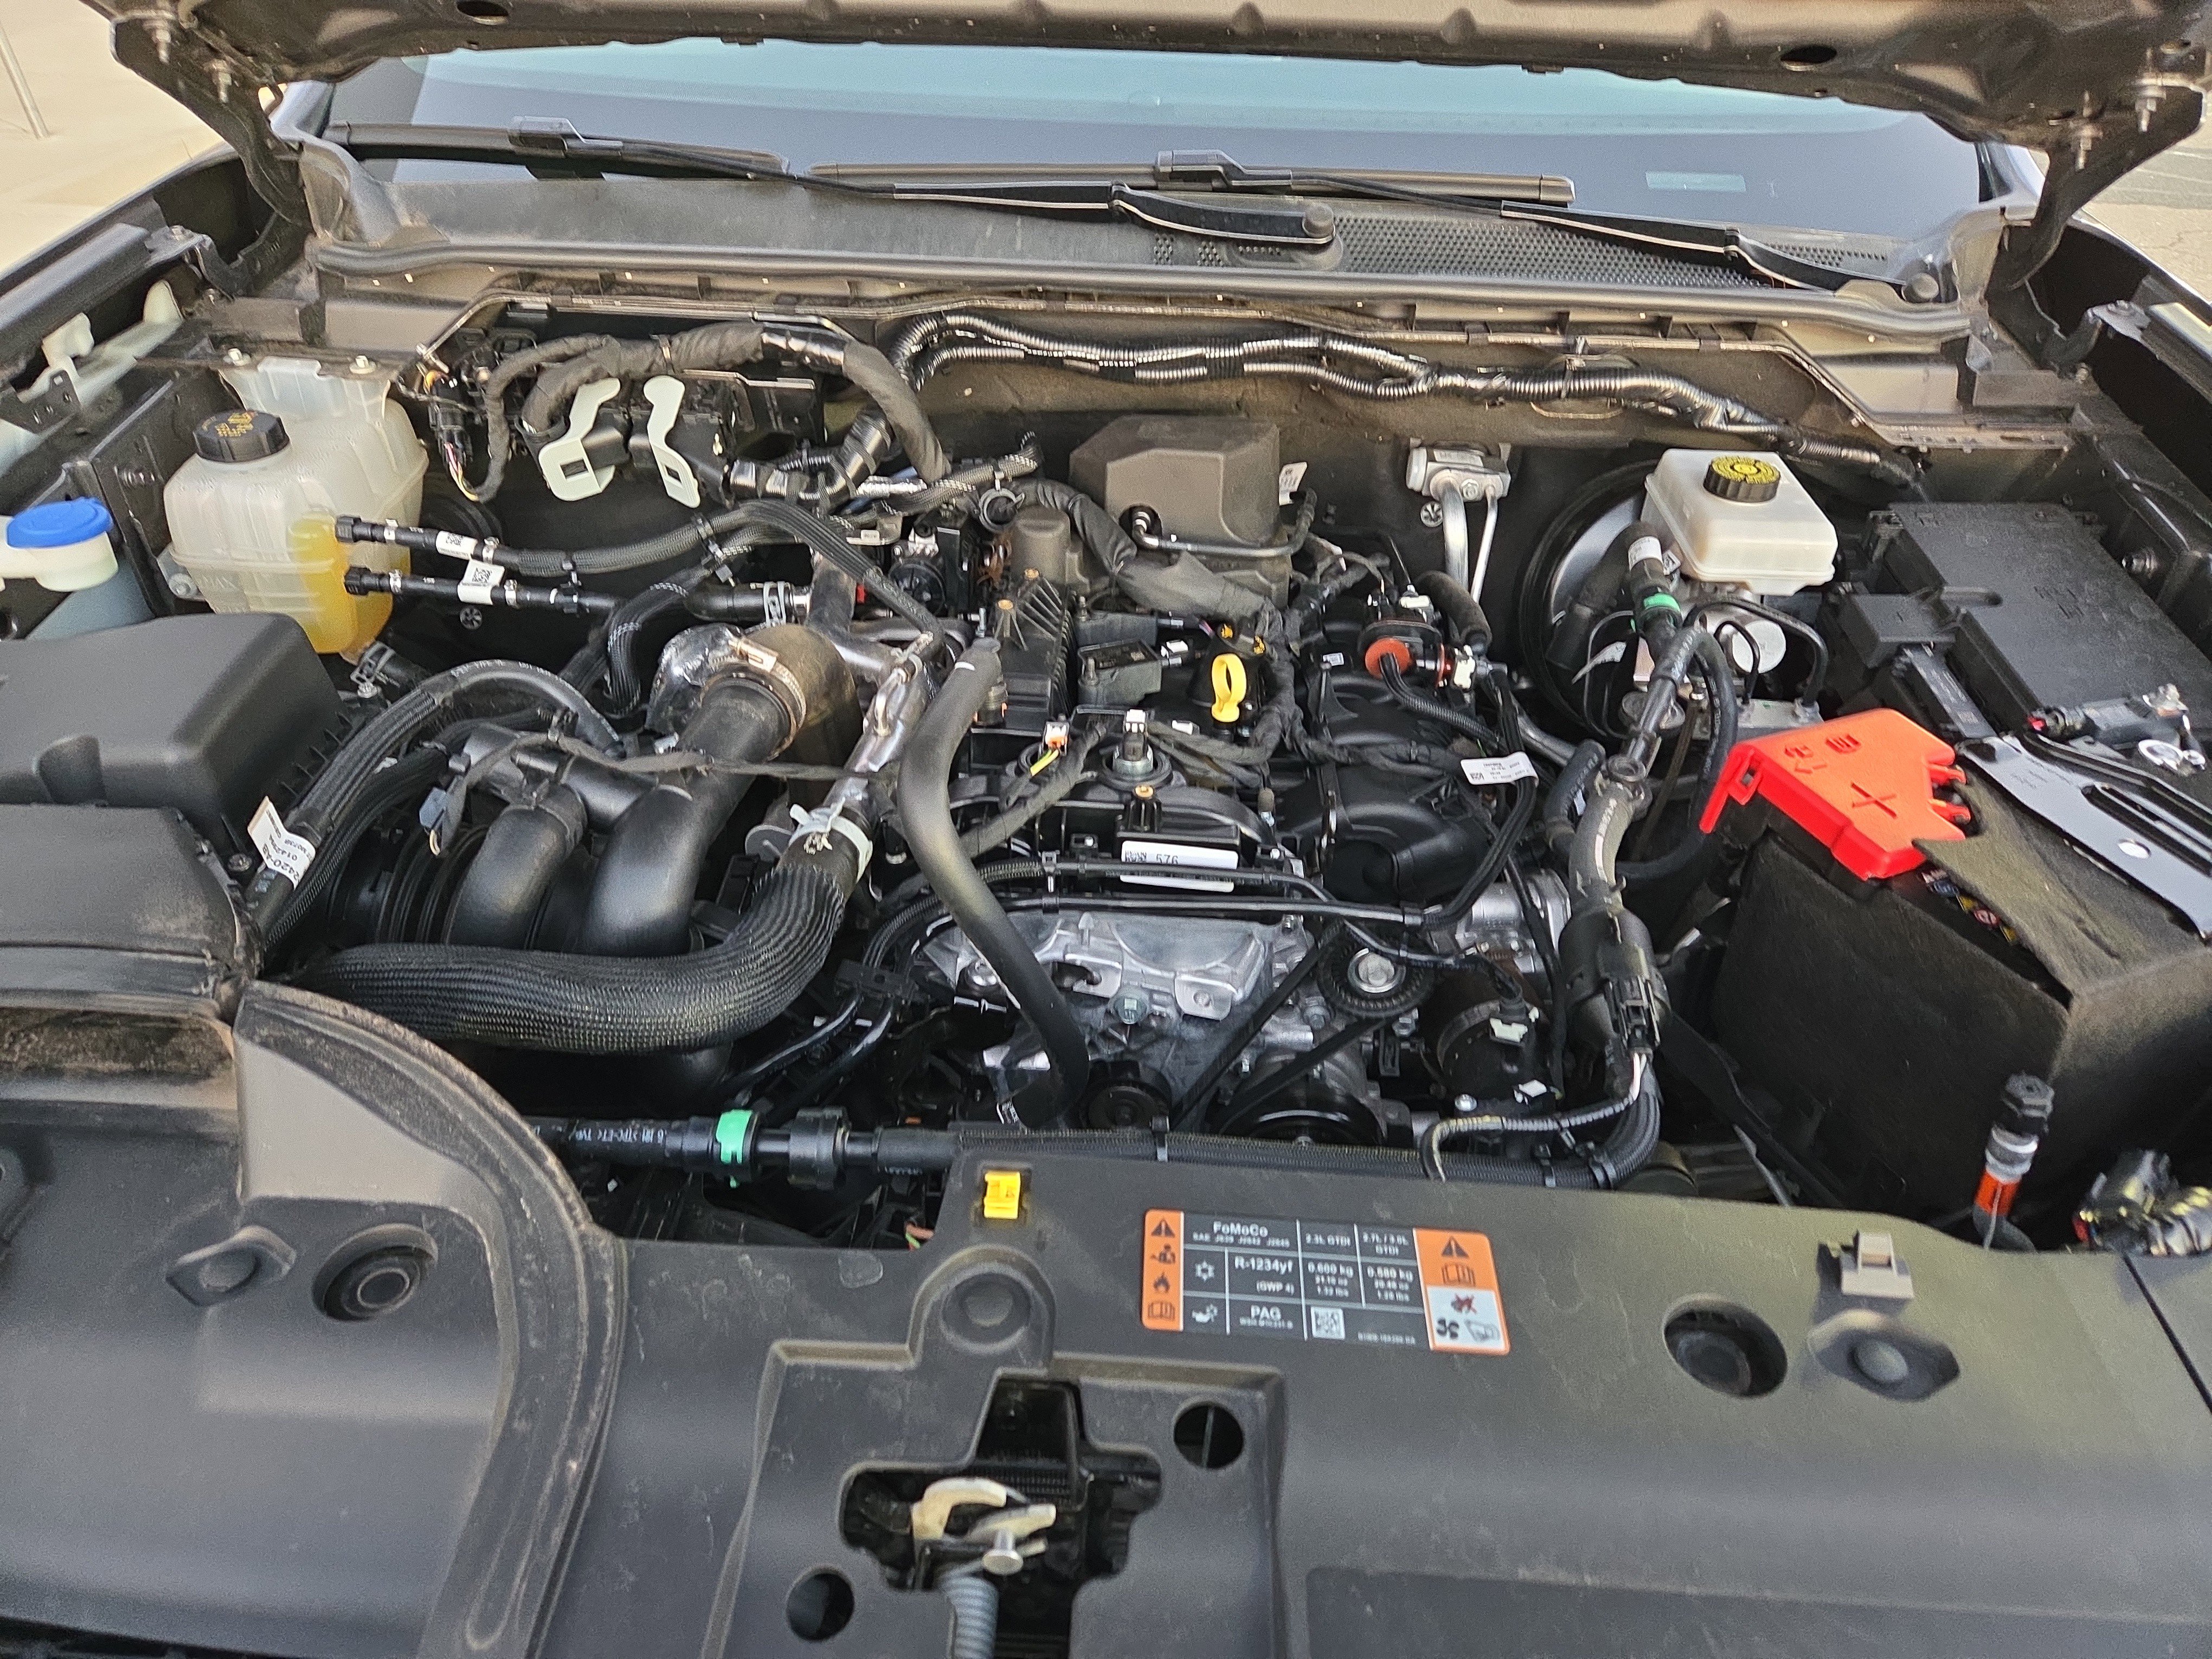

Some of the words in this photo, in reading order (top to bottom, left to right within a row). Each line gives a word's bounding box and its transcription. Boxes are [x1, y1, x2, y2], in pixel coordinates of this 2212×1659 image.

[1213, 1220, 1268, 1238] FoMoCo
[1234, 1255, 1293, 1275] R-1234yf
[1307, 1261, 1338, 1275] 0.600
[1339, 1263, 1354, 1278] kg
[1399, 1267, 1414, 1283] kg
[1251, 1304, 1282, 1321] PAG
